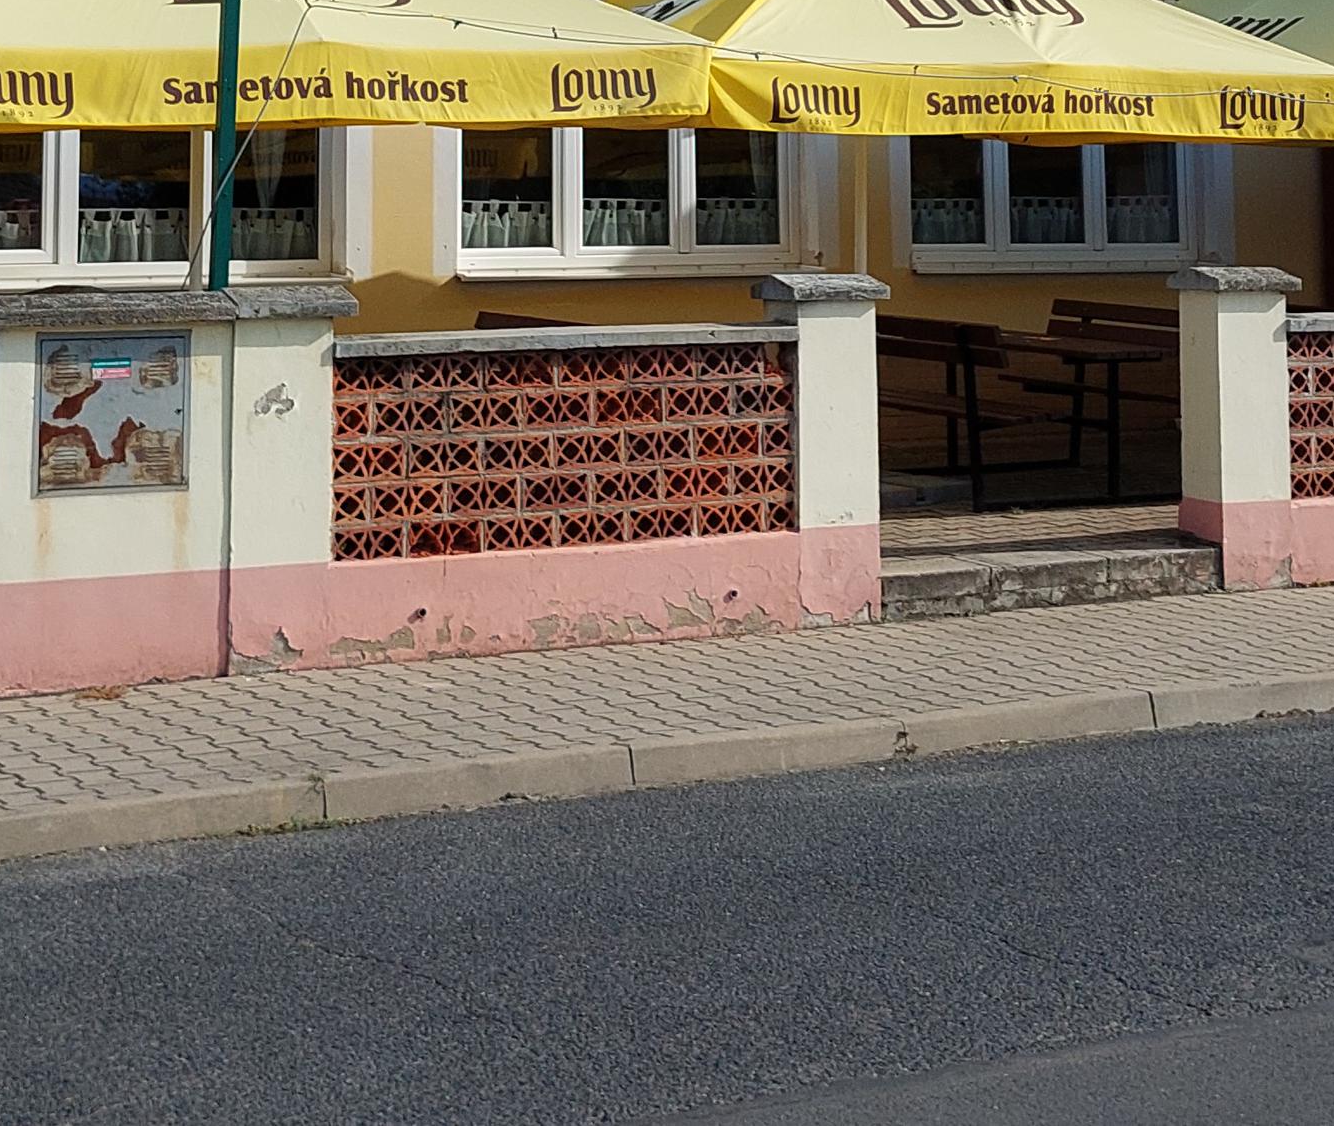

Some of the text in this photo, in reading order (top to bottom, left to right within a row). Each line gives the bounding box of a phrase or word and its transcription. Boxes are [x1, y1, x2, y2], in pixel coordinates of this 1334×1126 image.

[345, 71, 469, 104] hořkost
[551, 62, 657, 112] Louny
[769, 76, 1305, 132] Louny Sametová hořkost Louny
